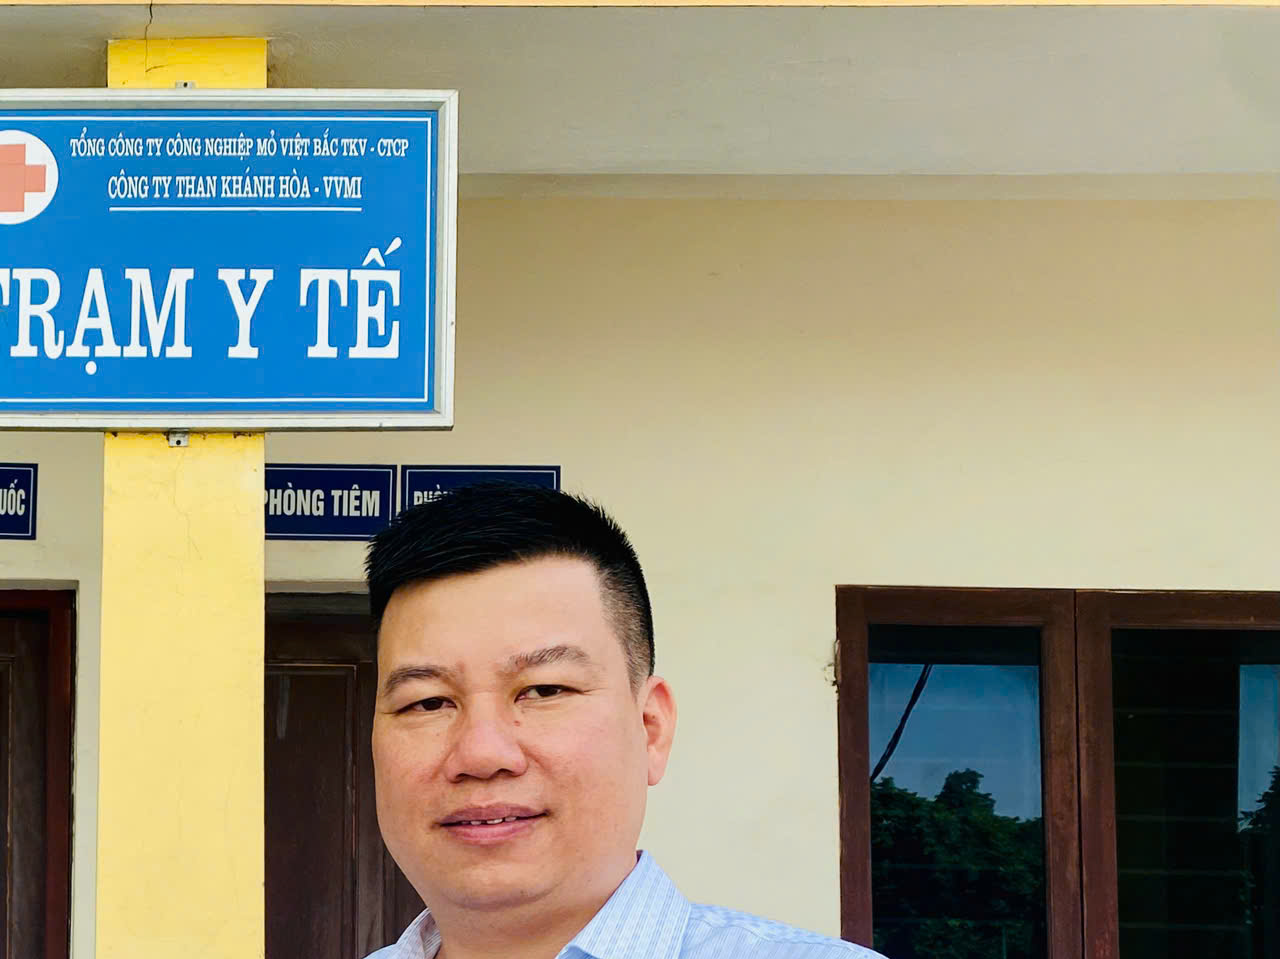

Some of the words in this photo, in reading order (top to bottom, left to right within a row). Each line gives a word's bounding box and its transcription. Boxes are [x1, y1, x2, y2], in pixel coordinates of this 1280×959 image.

[70, 127, 106, 157] TỔNG
[108, 132, 144, 157] CÔNG
[145, 138, 163, 156] TY
[166, 132, 202, 157] CÔNG
[204, 132, 254, 161] NGHIỆP
[256, 129, 277, 157] MỎ
[280, 132, 310, 161] VIỆT
[313, 128, 338, 157] BẮC
[341, 138, 368, 156] TKV
[377, 138, 409, 157] CTCP
[108, 168, 149, 199] CÔNG
[152, 175, 172, 198] TY
[175, 175, 218, 198] THAN
[220, 166, 276, 199] KHÁNH
[278, 168, 311, 199] HÒA
[322, 176, 362, 199] VVMI
[217, 267, 274, 360] Y
[299, 236, 402, 360] TẾ
[331, 484, 380, 517] TIÊM
